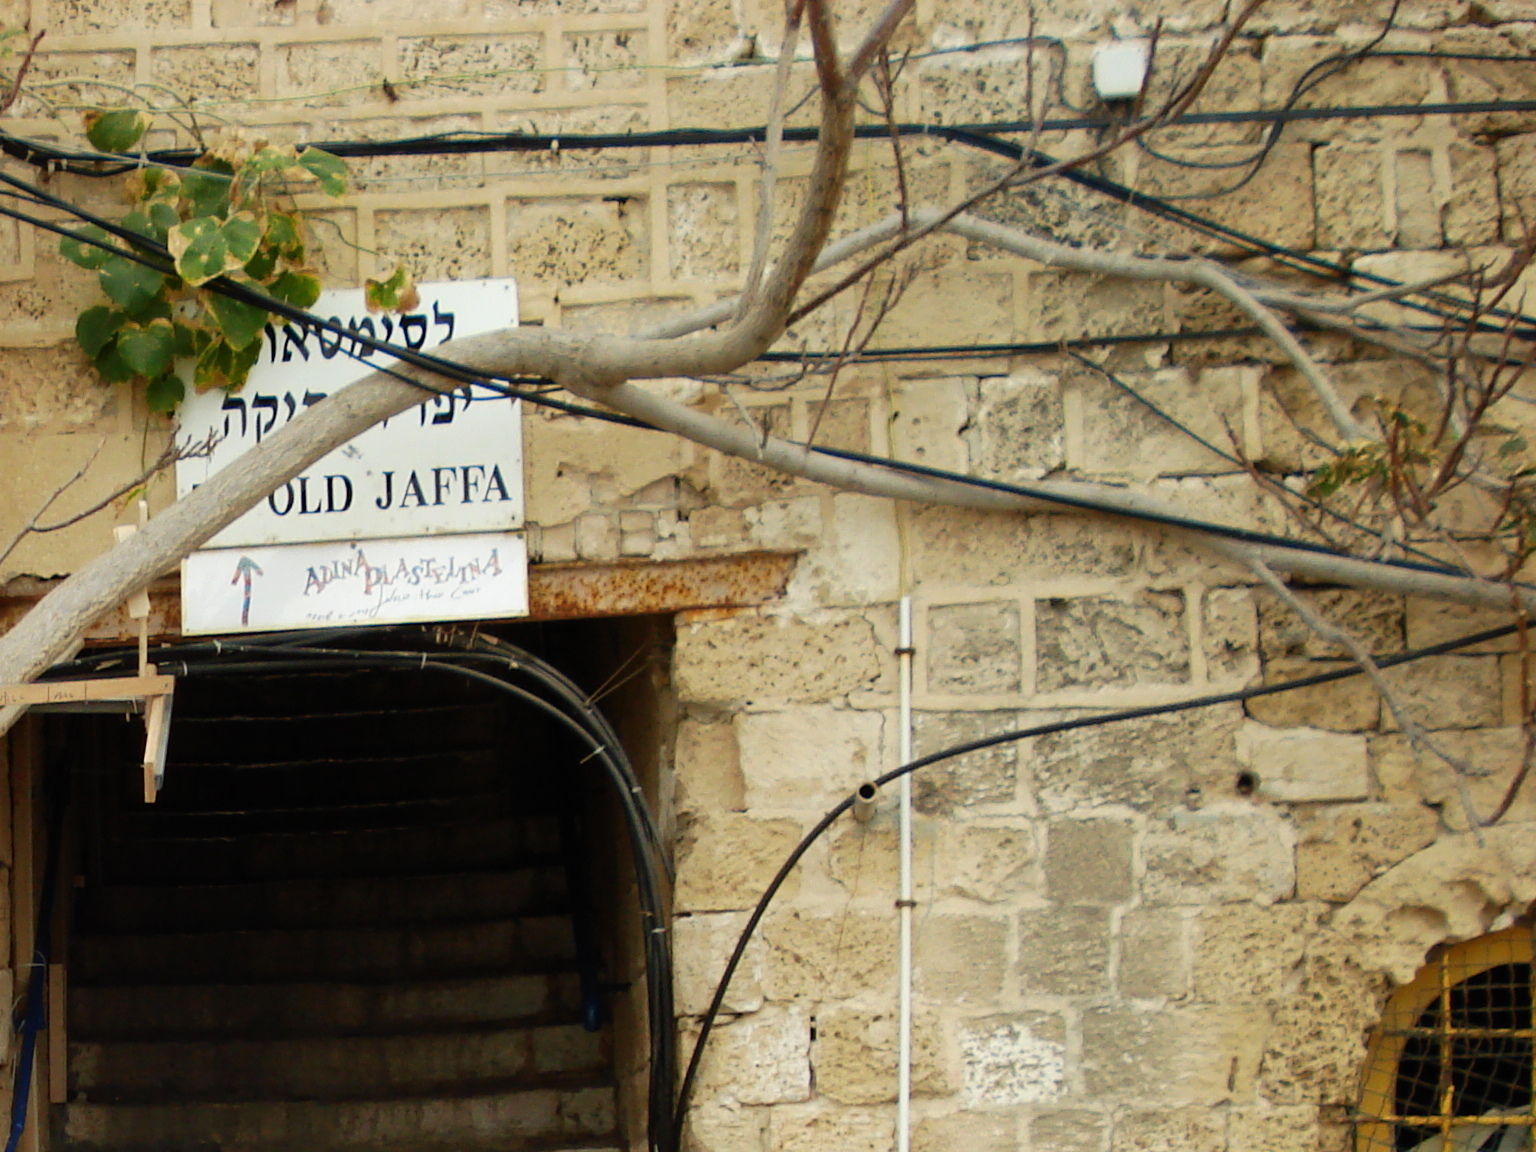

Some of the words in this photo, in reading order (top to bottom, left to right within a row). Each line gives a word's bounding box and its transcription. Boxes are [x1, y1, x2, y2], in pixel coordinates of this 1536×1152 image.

[252, 300, 455, 366] לסימטאו
[267, 474, 353, 516] OLD
[375, 464, 512, 509] JAFFA
[303, 549, 368, 596] ADINA
[364, 547, 503, 595] PLASTELINA
